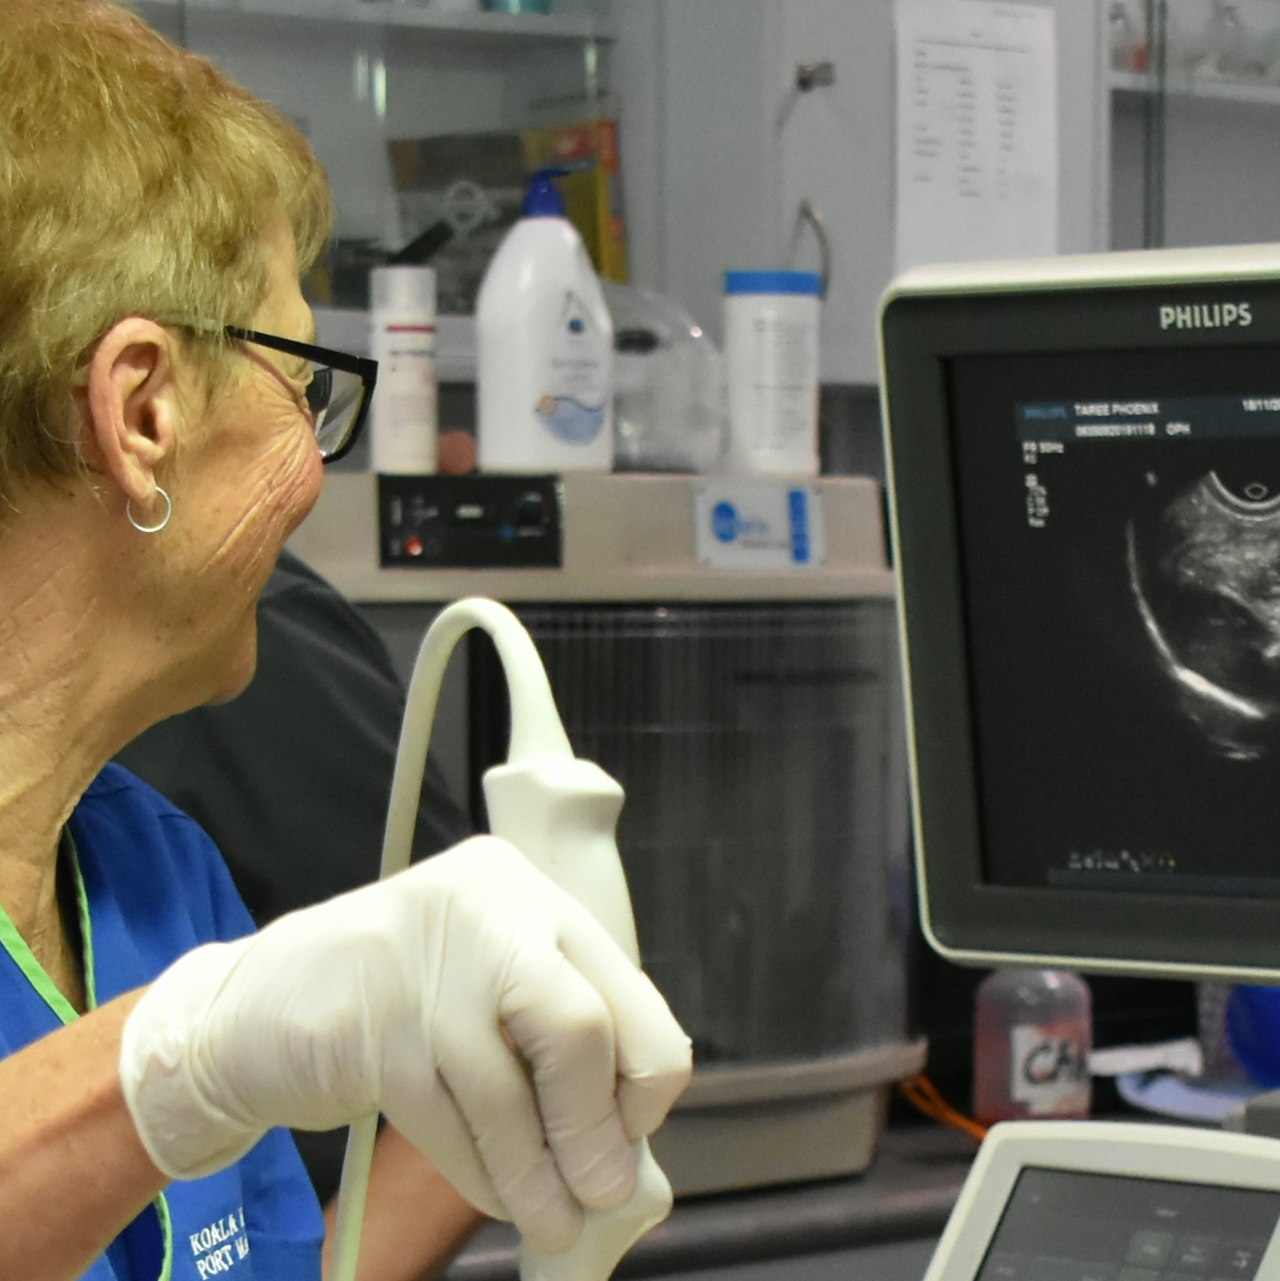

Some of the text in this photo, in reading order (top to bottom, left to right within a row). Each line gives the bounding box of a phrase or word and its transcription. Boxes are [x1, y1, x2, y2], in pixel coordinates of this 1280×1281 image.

[1160, 303, 1252, 330] PHILIPS
[189, 1213, 239, 1256] KOALA
[196, 1244, 234, 1281] PORT
